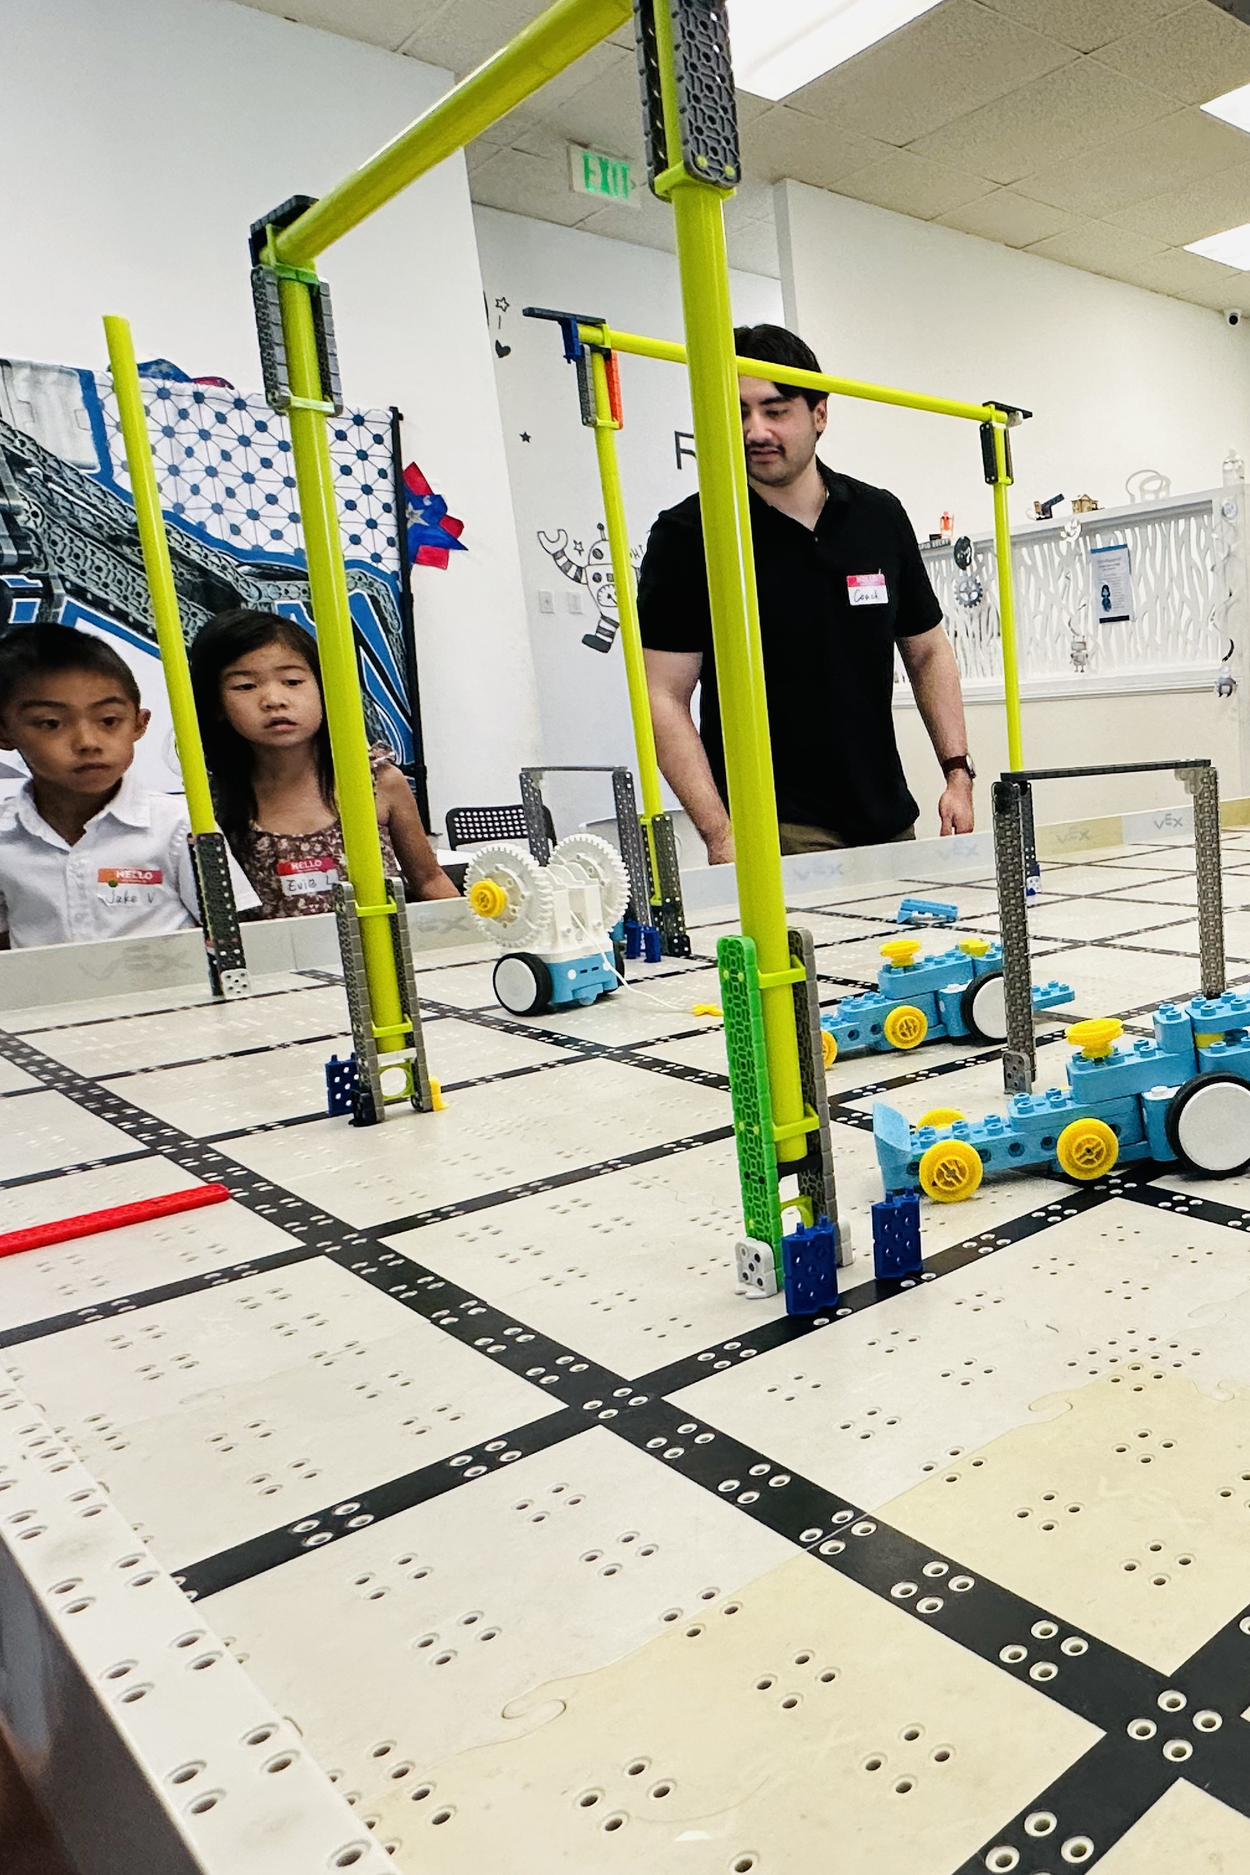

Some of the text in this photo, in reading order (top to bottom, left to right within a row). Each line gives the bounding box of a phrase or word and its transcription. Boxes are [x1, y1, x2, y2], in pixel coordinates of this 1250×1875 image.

[582, 150, 630, 200] EXIT
[1154, 813, 1184, 830] VEX
[289, 859, 322, 870] HELLO
[115, 870, 153, 881] HELLO
